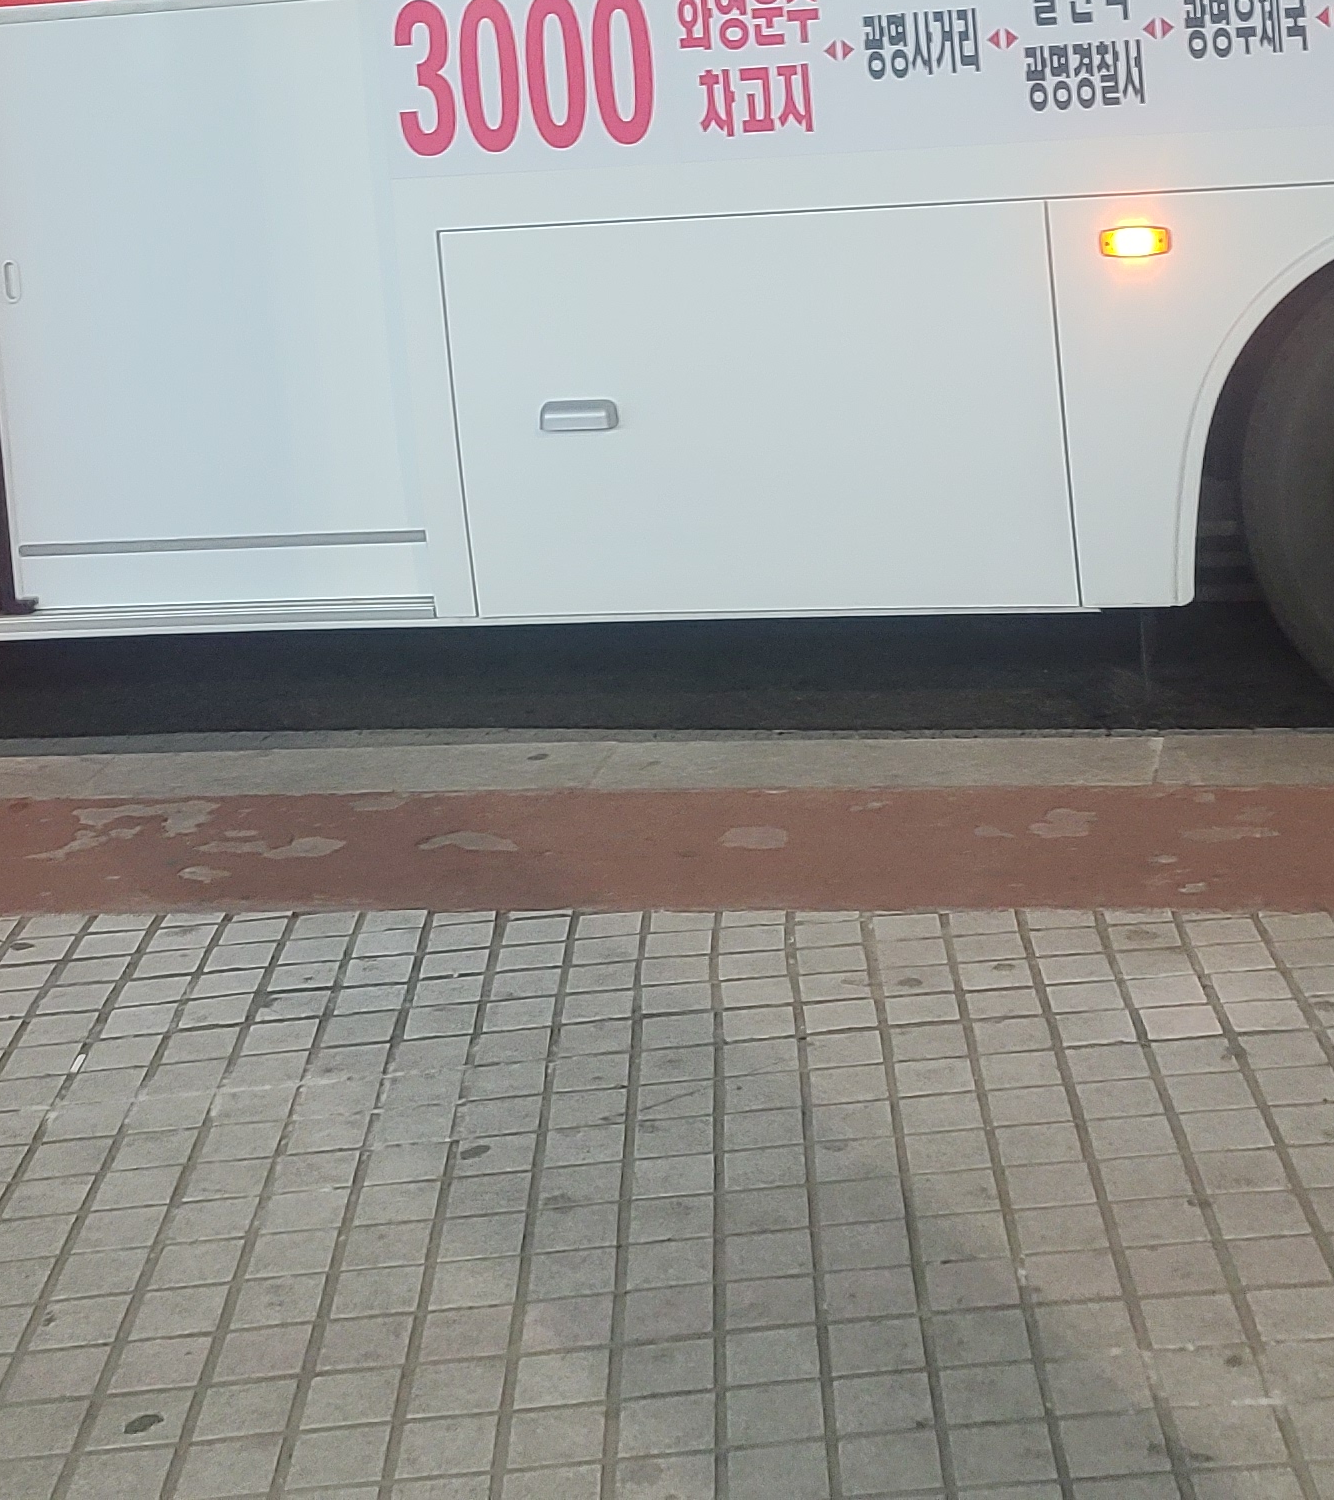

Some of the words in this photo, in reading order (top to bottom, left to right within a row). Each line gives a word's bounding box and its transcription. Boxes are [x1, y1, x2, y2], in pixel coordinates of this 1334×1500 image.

[862, 8, 981, 80] 광명사거리
[1023, 39, 1147, 112] 광명경찰서
[698, 63, 814, 138] 차고지
